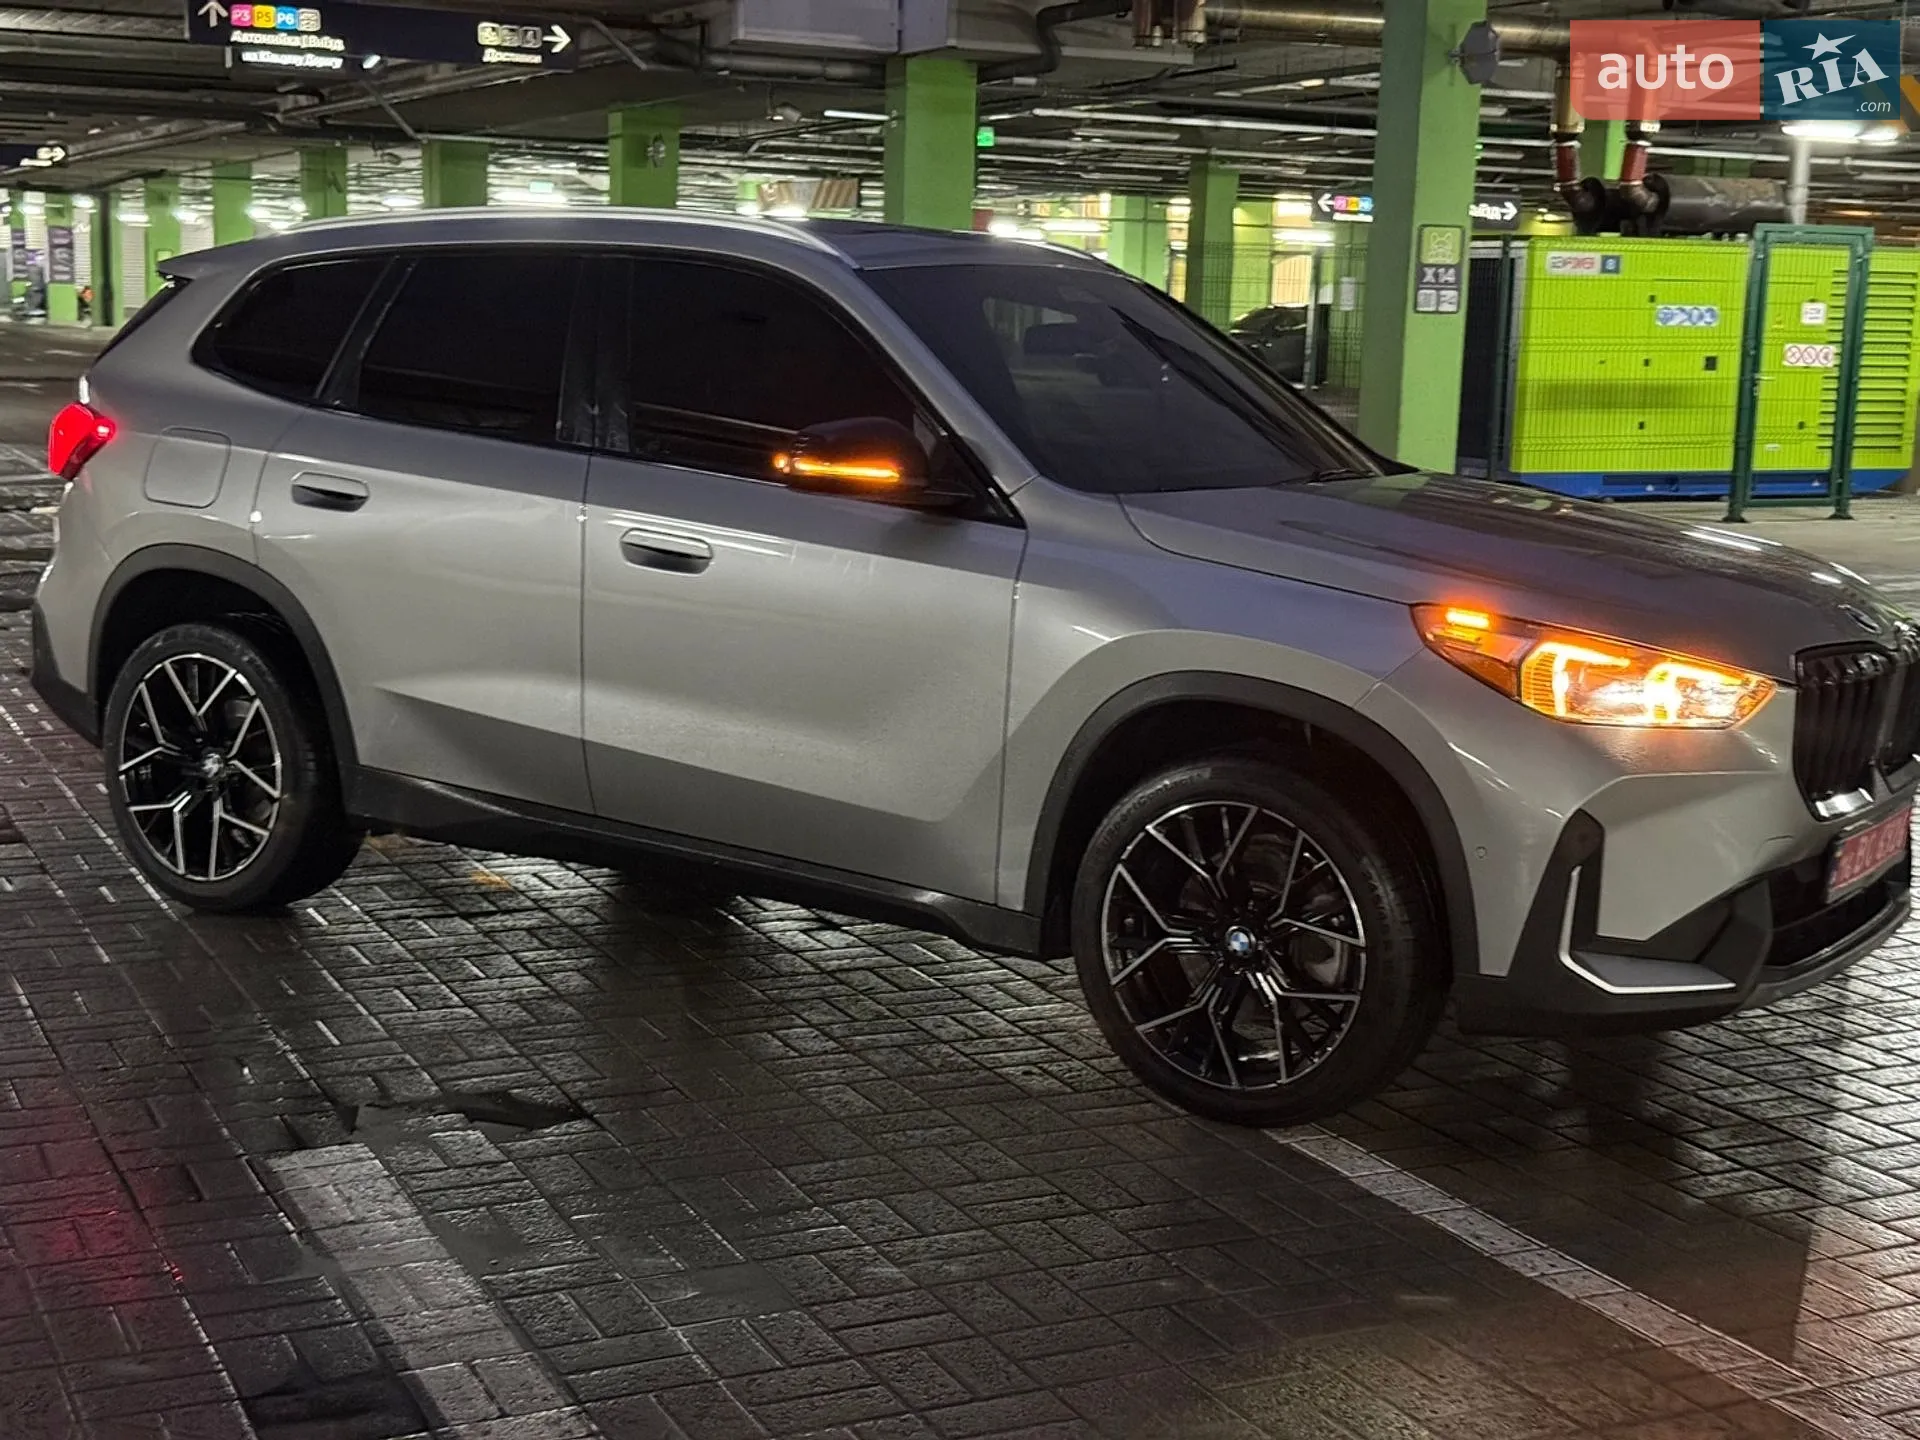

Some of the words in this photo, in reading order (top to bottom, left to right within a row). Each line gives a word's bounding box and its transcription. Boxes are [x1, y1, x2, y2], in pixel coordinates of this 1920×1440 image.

[231, 9, 250, 21] P3
[256, 11, 272, 22] P5
[277, 11, 295, 24] P6
